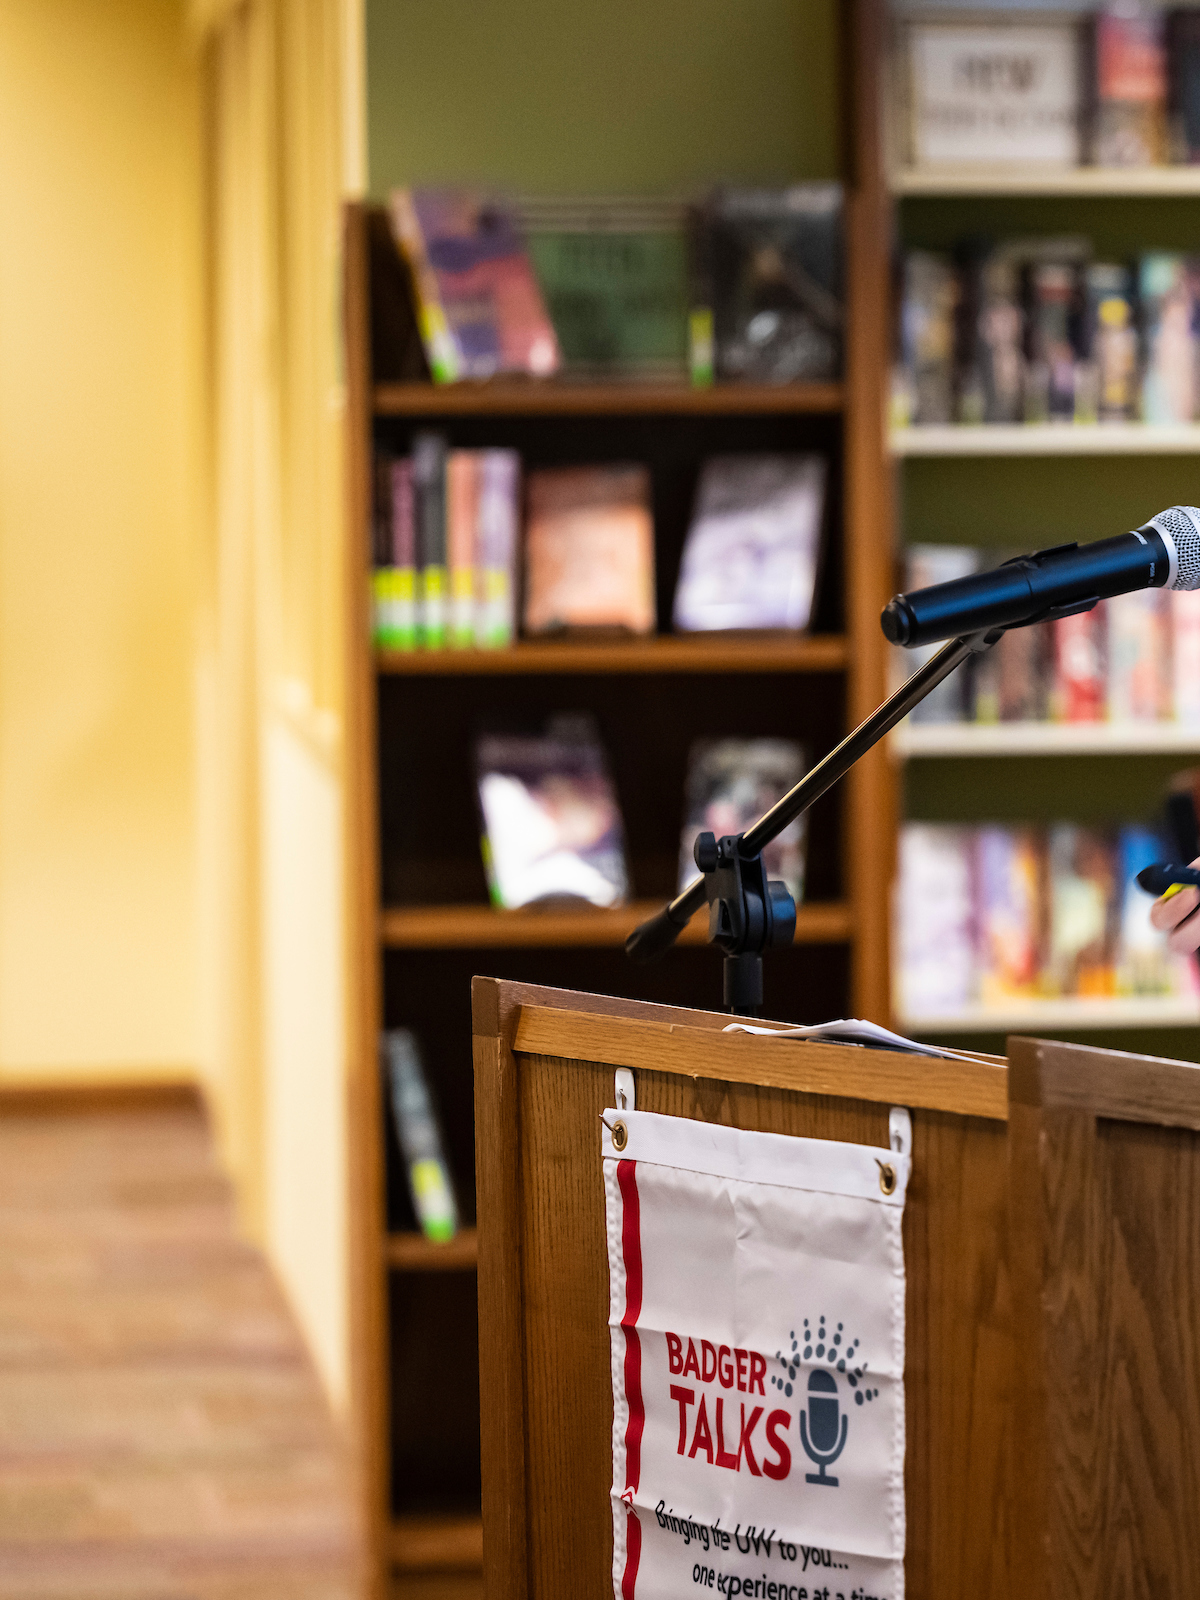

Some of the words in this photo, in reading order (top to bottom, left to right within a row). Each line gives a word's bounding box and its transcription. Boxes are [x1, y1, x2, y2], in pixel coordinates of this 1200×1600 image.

[665, 1331, 767, 1396] BADGER
[669, 1383, 792, 1481] TALKS
[655, 1499, 710, 1551] Bringing
[734, 1523, 776, 1558] UW
[778, 1538, 798, 1561] to
[800, 1544, 849, 1572] you...
[692, 1563, 715, 1588] one
